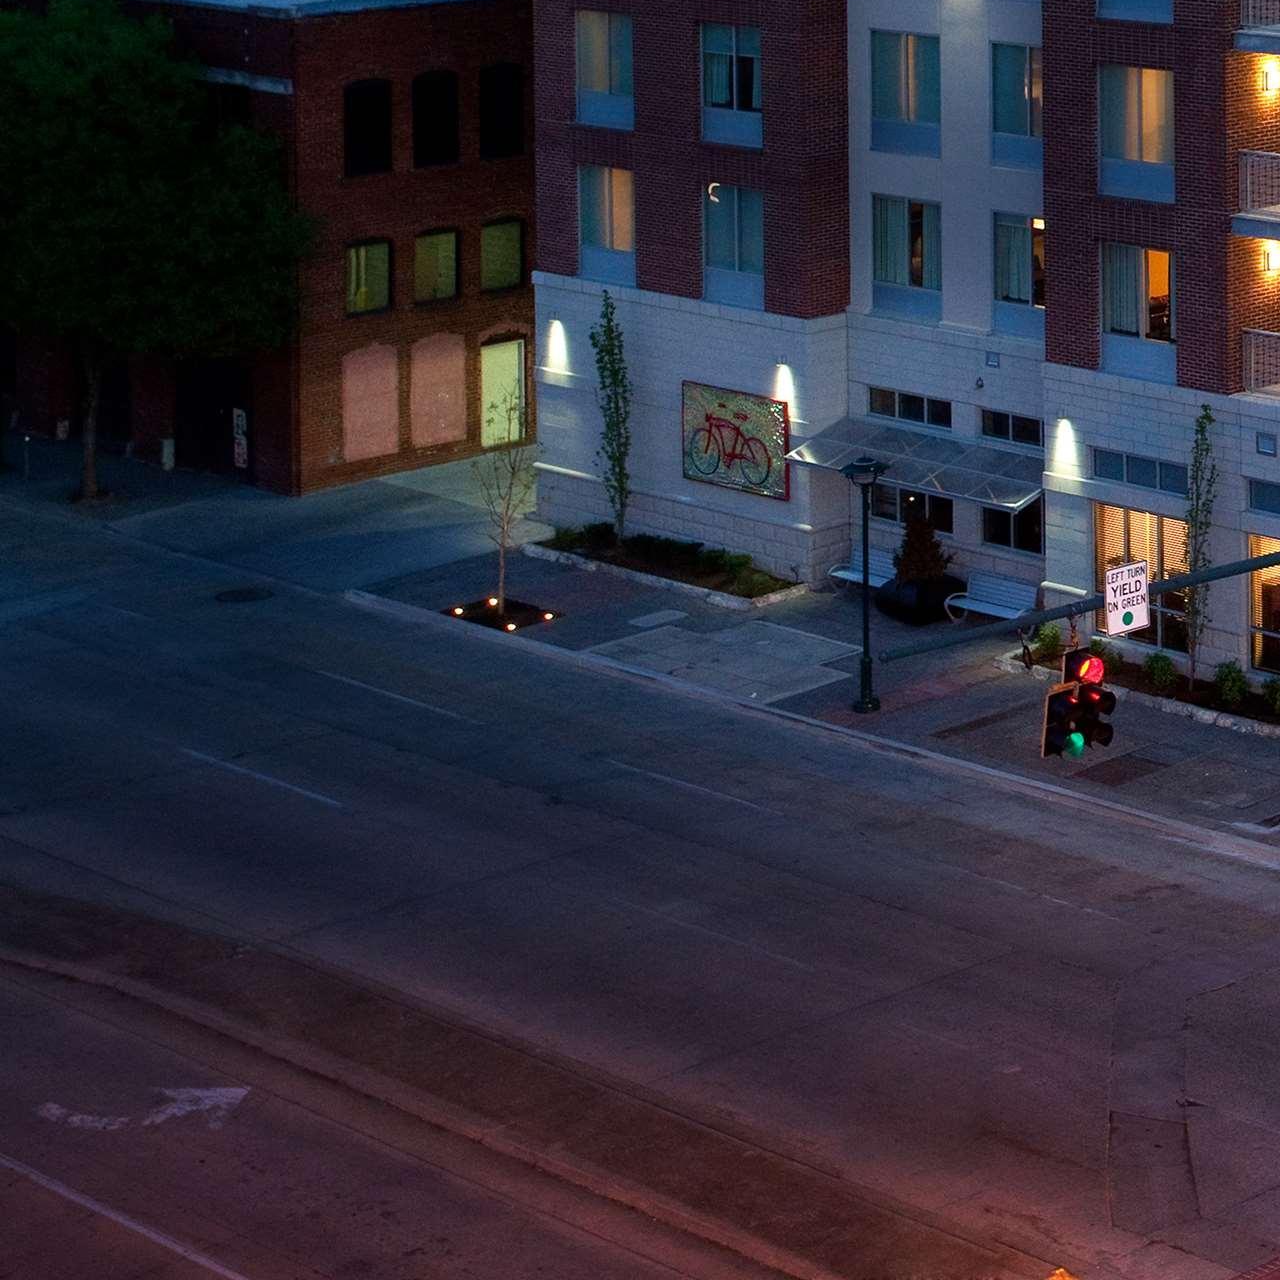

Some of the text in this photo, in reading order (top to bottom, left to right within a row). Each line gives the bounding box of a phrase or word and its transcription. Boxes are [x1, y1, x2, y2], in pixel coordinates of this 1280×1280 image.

[1107, 565, 1146, 585] LEFT TURN
[1111, 580, 1142, 598] YIELD
[1107, 594, 1146, 613] ON GREEN
